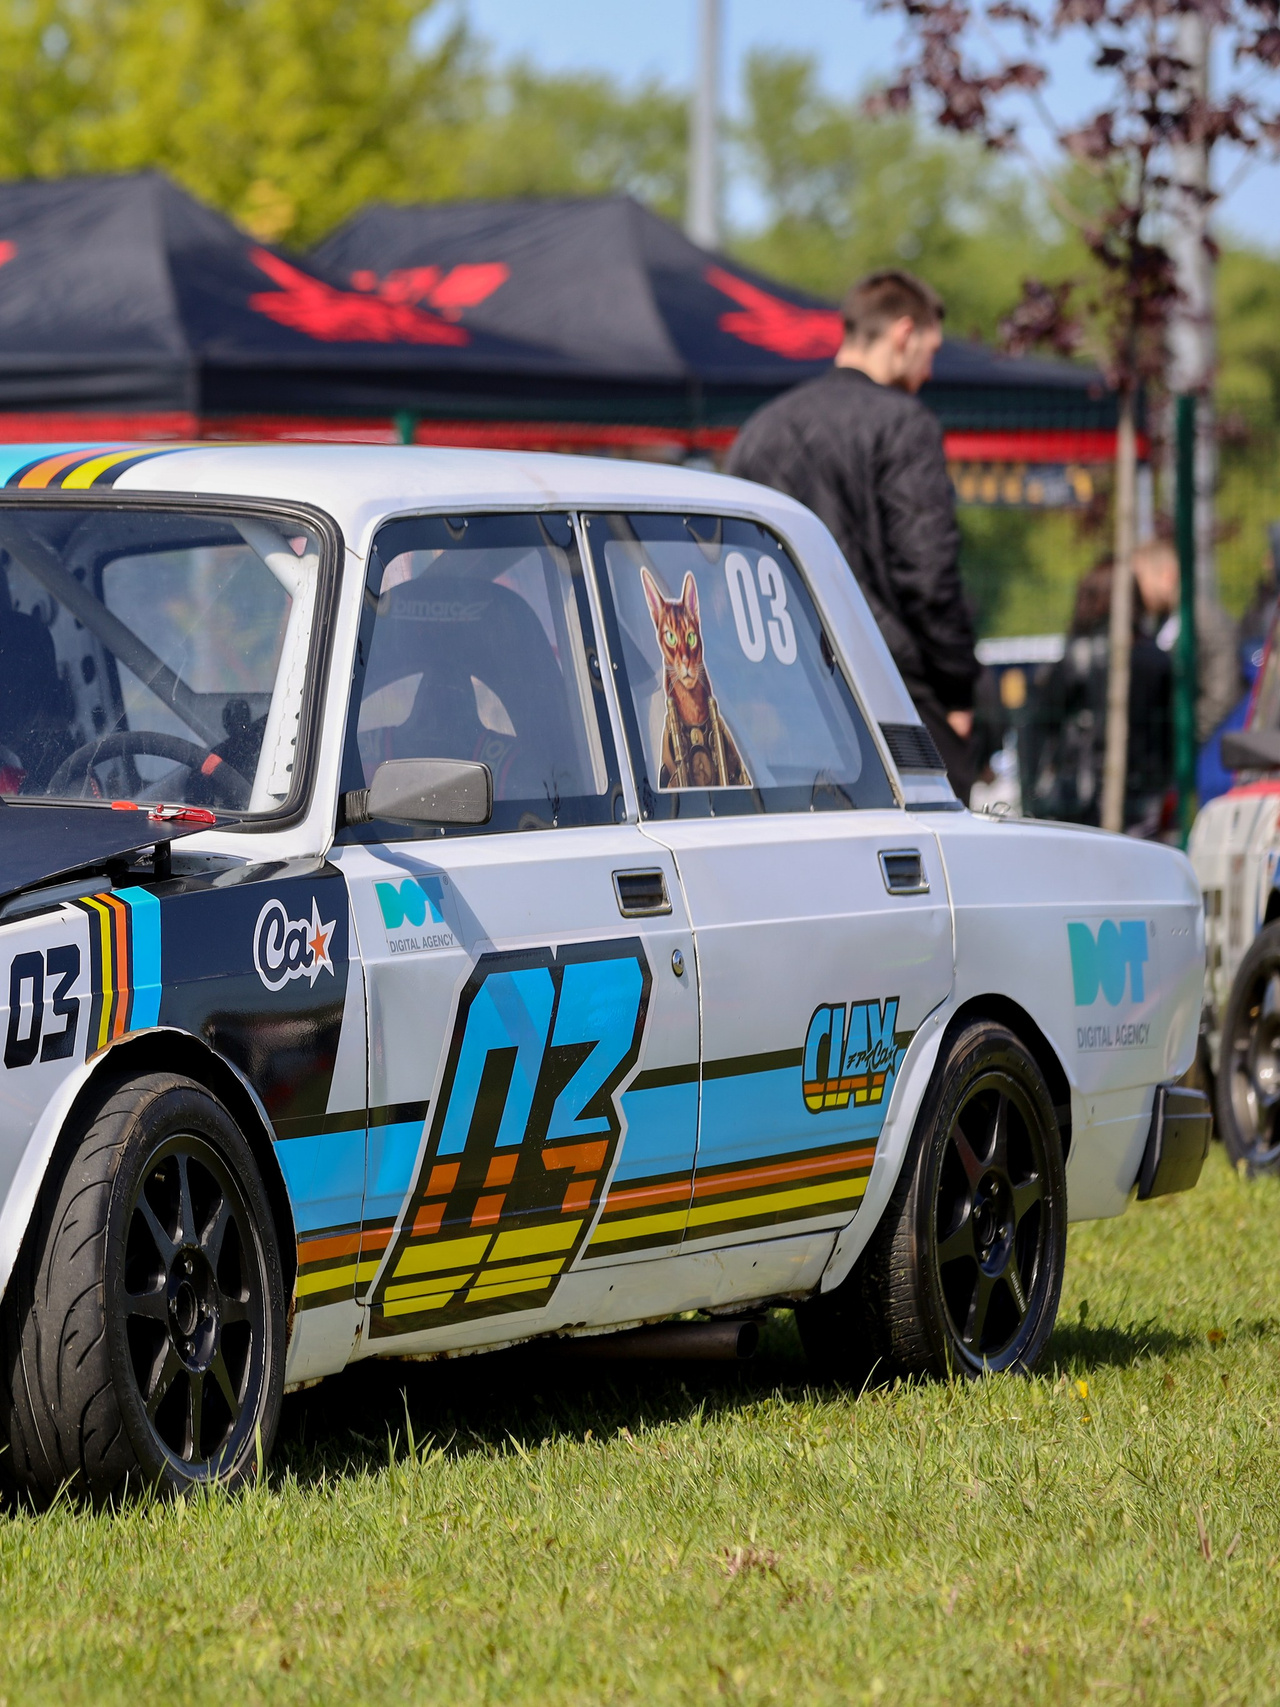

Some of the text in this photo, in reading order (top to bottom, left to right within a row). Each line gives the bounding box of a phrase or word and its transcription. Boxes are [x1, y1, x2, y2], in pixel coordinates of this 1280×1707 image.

[724, 551, 798, 666] 03
[374, 876, 444, 929] DOT
[389, 933, 454, 953] DIGITAL AGENCY
[1067, 919, 1149, 1007] DOT
[3, 943, 81, 1069] 03
[1077, 1023, 1151, 1048] DIGITAL AGENCY
